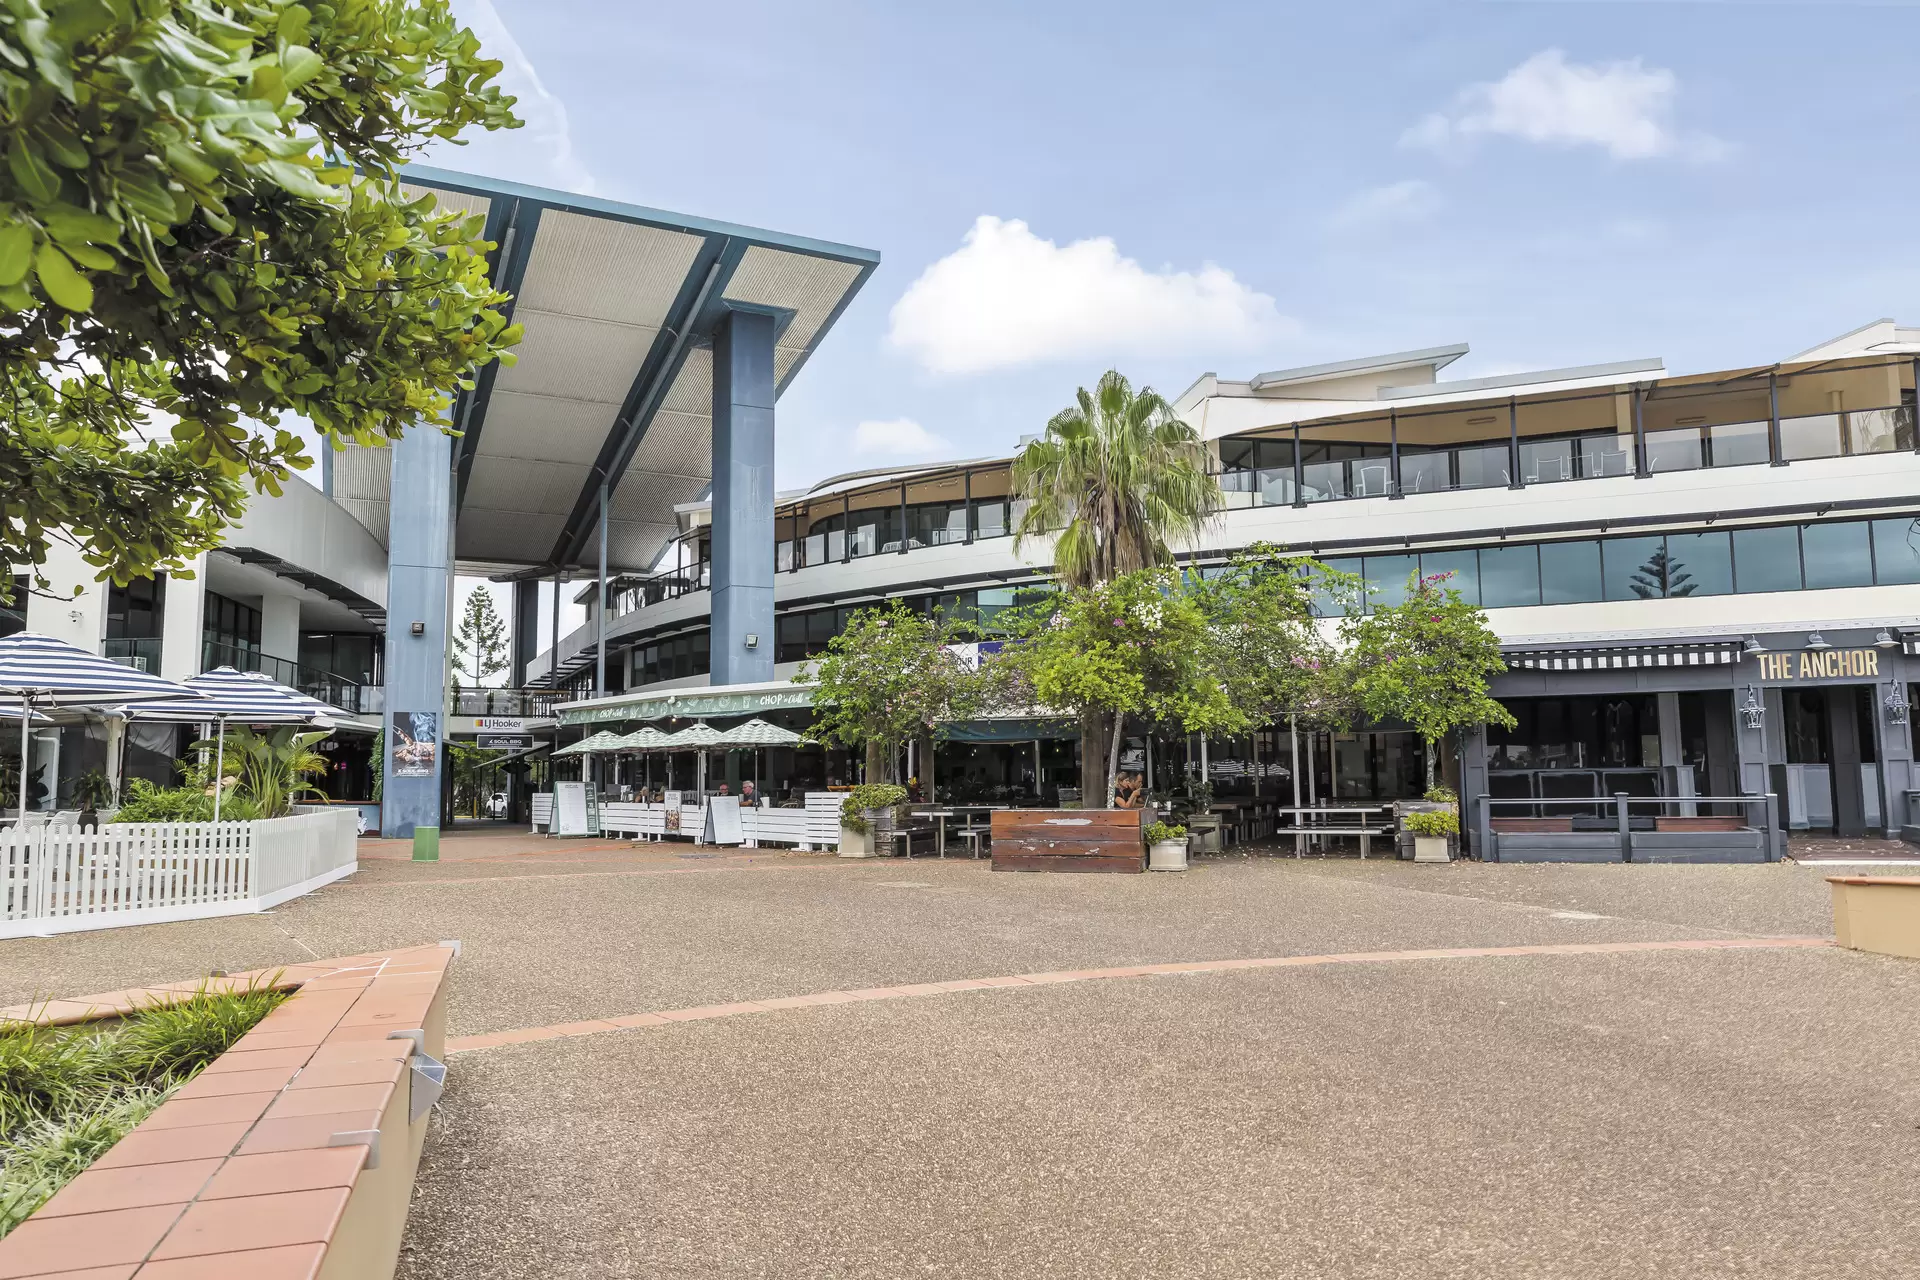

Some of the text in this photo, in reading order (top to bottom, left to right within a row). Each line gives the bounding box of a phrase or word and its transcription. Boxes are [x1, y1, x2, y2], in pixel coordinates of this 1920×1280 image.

[1756, 649, 1879, 680] THE ANCHOR
[760, 693, 782, 706] CHOP
[484, 719, 522, 729] LJ Hooker
